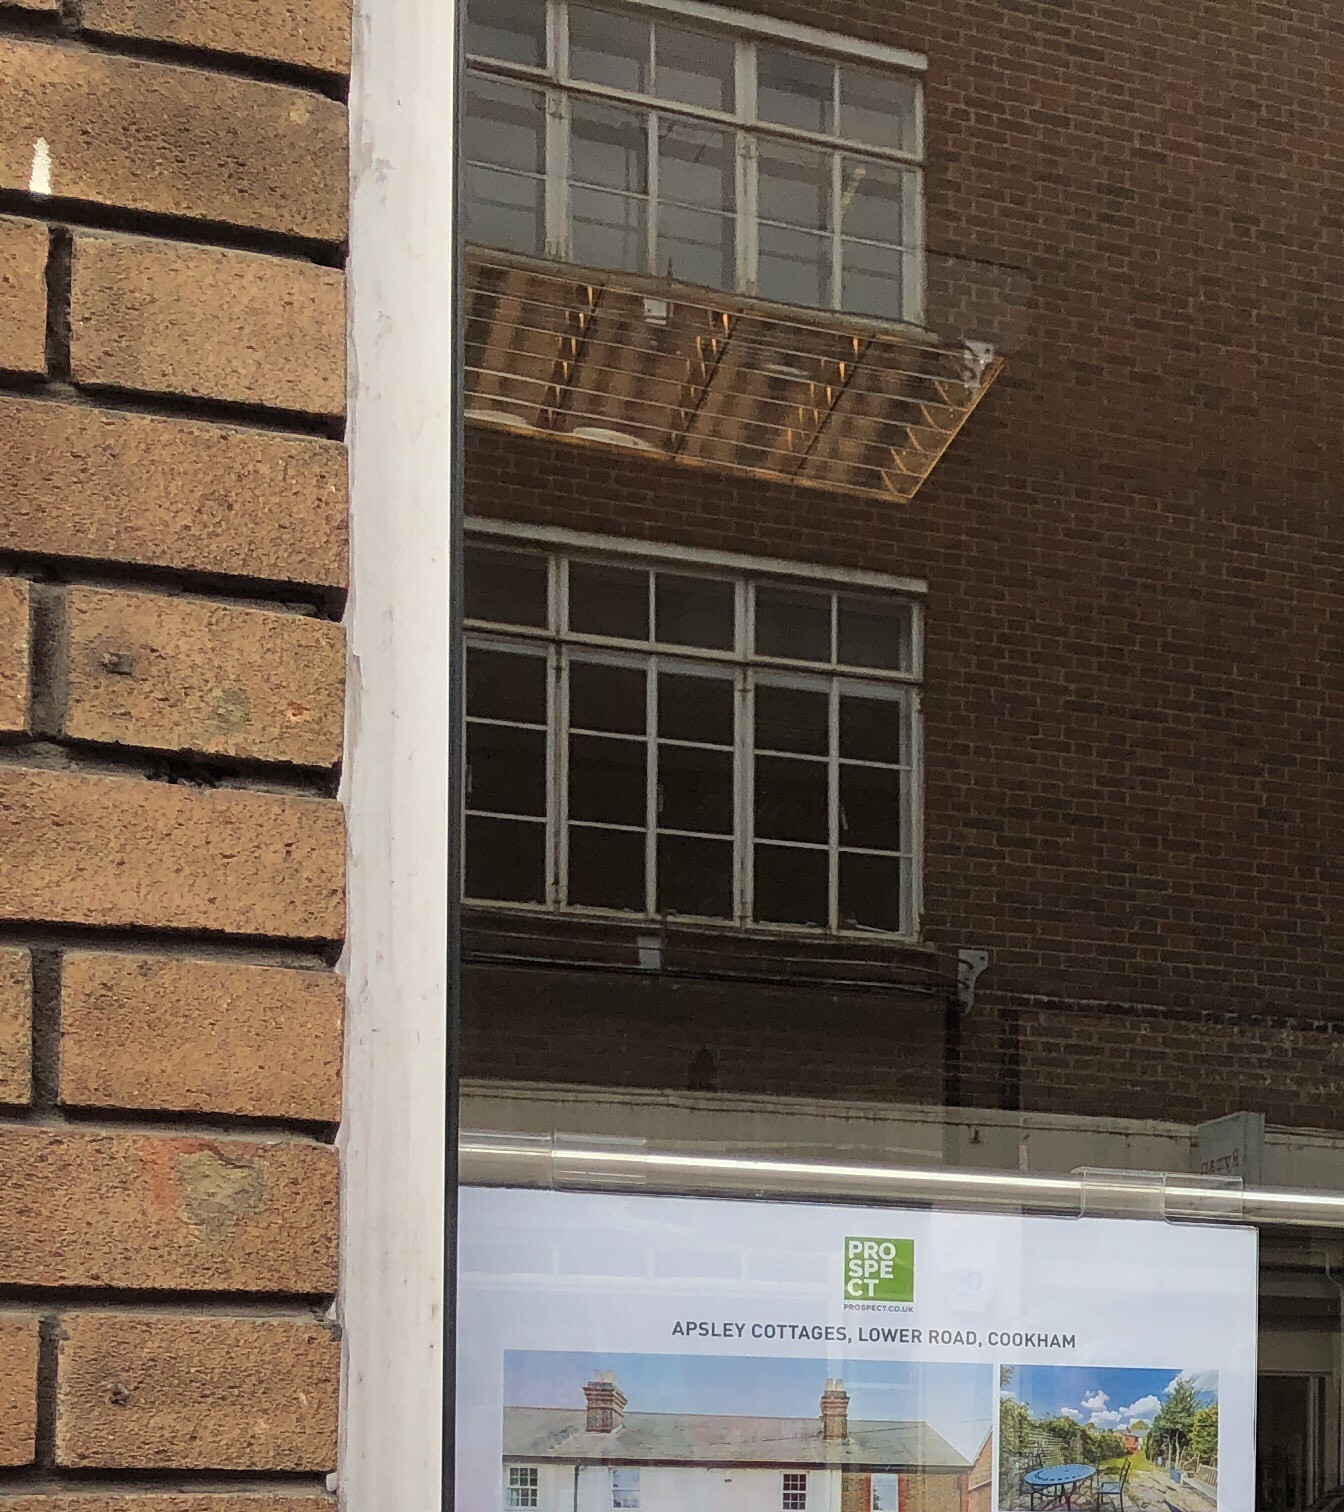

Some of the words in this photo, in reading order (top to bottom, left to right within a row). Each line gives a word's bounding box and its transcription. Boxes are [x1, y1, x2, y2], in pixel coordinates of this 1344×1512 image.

[848, 1240, 896, 1260] PRO
[848, 1259, 894, 1278] SPE
[847, 1278, 879, 1297] CT
[672, 1321, 745, 1338] APSLEY
[751, 1324, 851, 1343] COTTAGES,
[859, 1327, 921, 1343] LOWER
[928, 1330, 982, 1347] ROAD,
[988, 1332, 1076, 1348] COOKHAM
